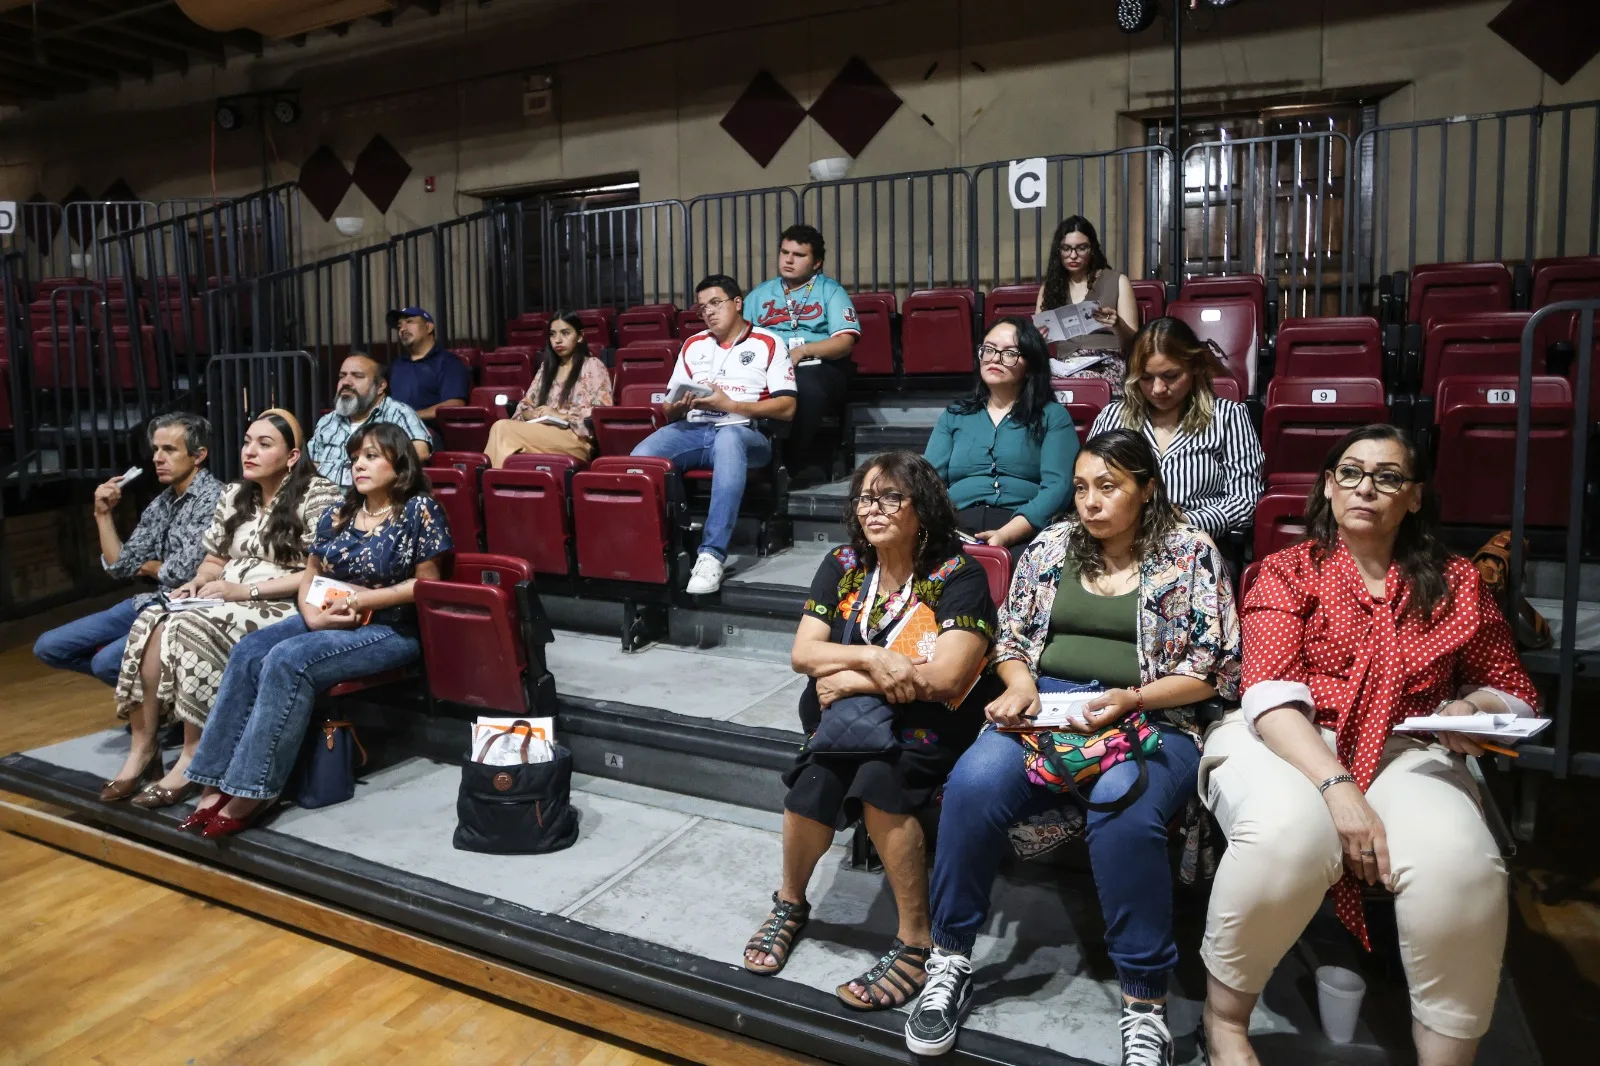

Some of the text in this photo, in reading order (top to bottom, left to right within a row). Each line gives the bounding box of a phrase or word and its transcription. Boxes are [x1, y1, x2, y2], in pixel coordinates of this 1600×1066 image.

[1014, 171, 1041, 204] C
[655, 394, 661, 402] 5
[1320, 391, 1328, 402] 9
[1494, 391, 1510, 402] 10
[817, 533, 825, 542] C
[727, 625, 734, 635] B
[610, 755, 618, 766] A
